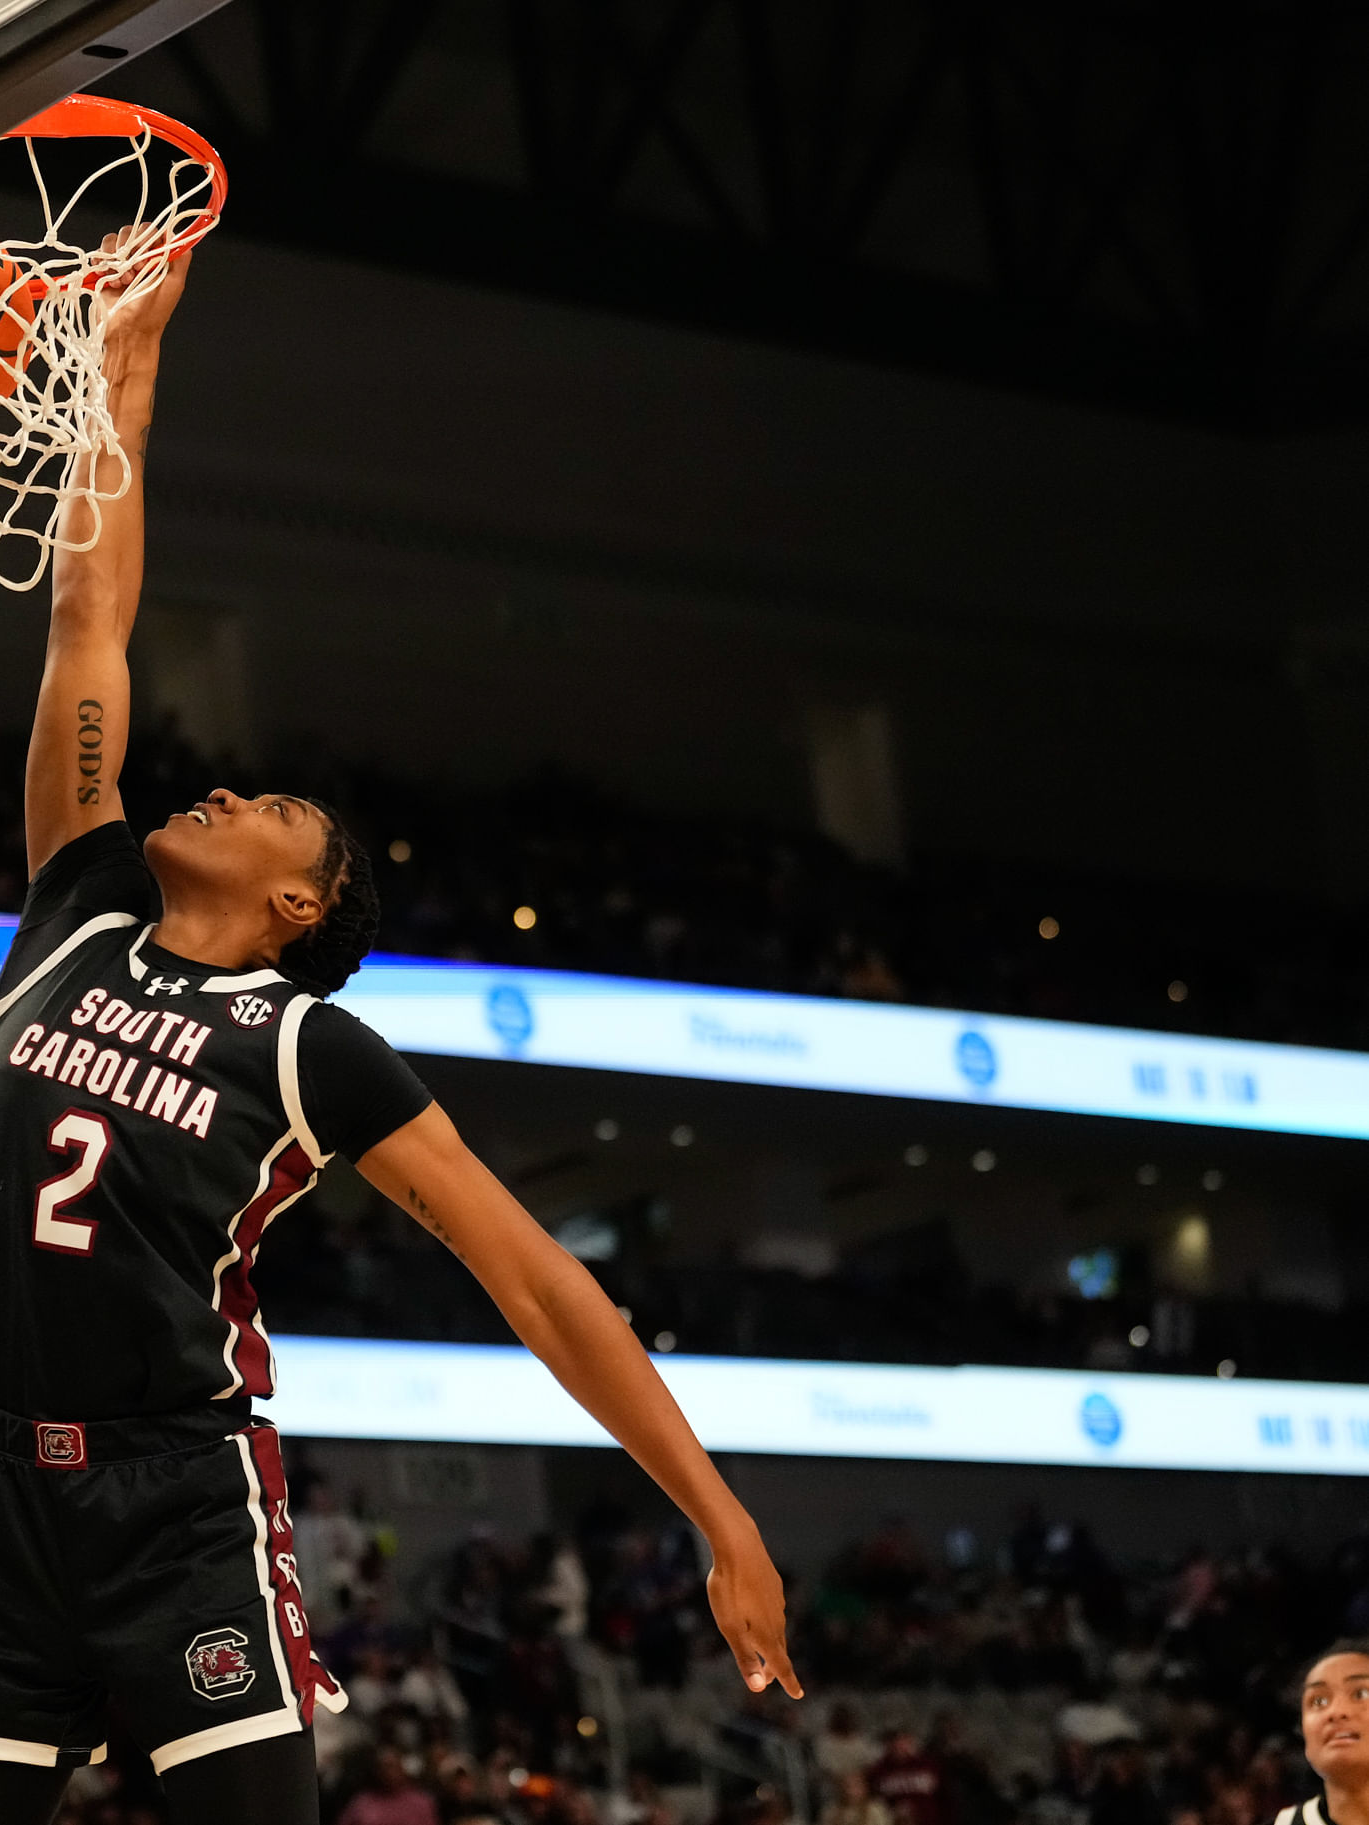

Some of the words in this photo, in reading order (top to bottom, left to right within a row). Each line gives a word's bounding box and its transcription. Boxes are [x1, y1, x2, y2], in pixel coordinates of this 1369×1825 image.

[77, 699, 104, 806] GOD'S
[71, 987, 213, 1066] SOUTH
[230, 994, 273, 1027] SEC
[9, 1023, 219, 1139] CAROLINA
[33, 1107, 113, 1257] 2
